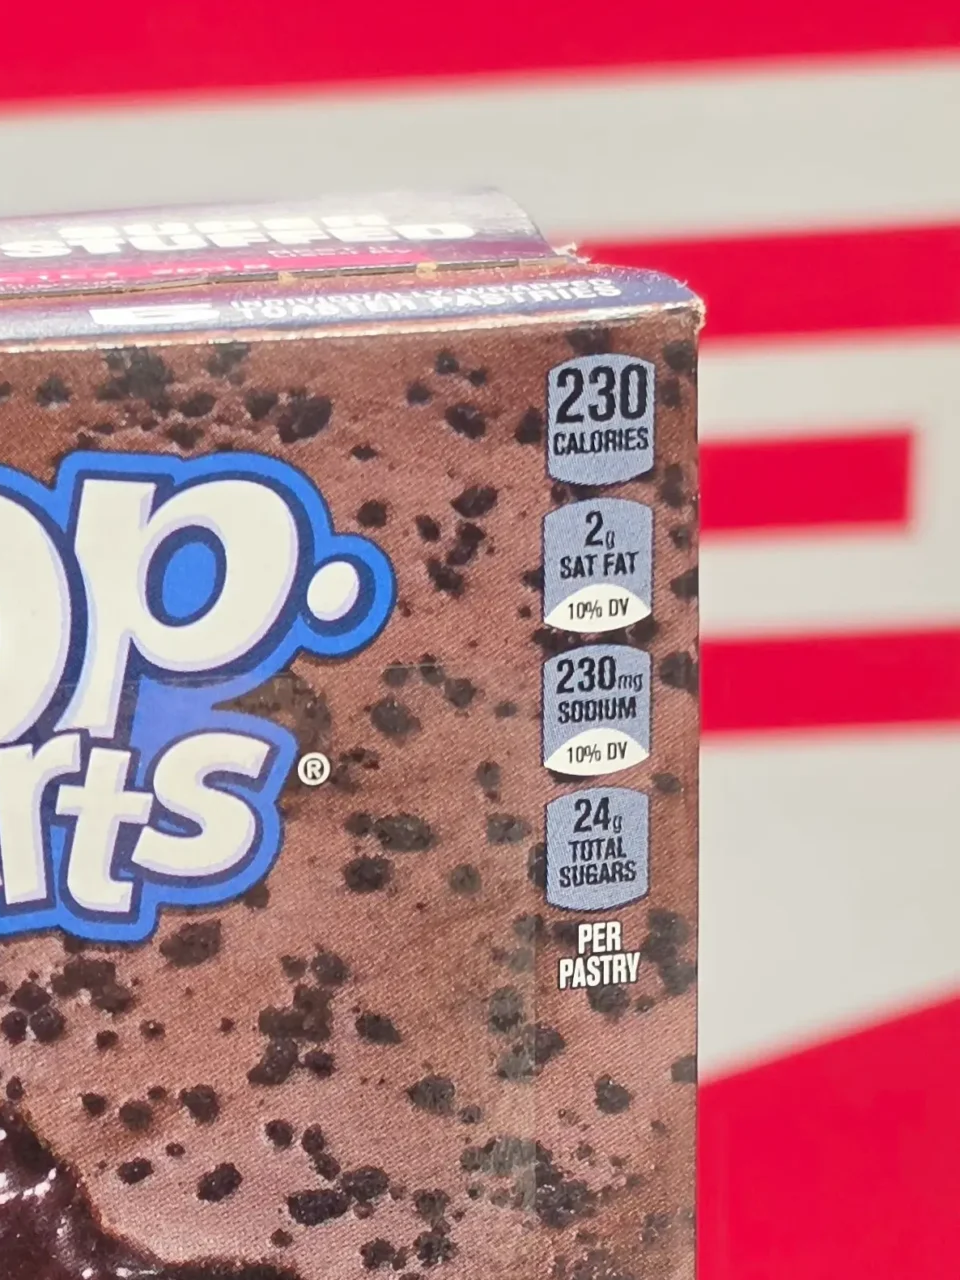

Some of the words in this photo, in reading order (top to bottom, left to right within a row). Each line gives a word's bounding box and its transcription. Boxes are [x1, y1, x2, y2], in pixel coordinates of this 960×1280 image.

[239, 299, 418, 320] TOASTER
[430, 285, 623, 309] PASTRIES
[555, 363, 648, 424] 230
[553, 427, 649, 456] CALORIES
[560, 554, 596, 579] SAT
[603, 551, 639, 577] FAT
[568, 600, 602, 620] 10%
[609, 598, 630, 618] DV
[557, 697, 637, 724] SODIUM
[567, 744, 601, 765] 10%
[607, 742, 628, 761] DV
[568, 837, 627, 862] TOTAL
[559, 860, 637, 888] SUGARS
[577, 920, 622, 954] PER
[558, 951, 641, 990] PASTRY
